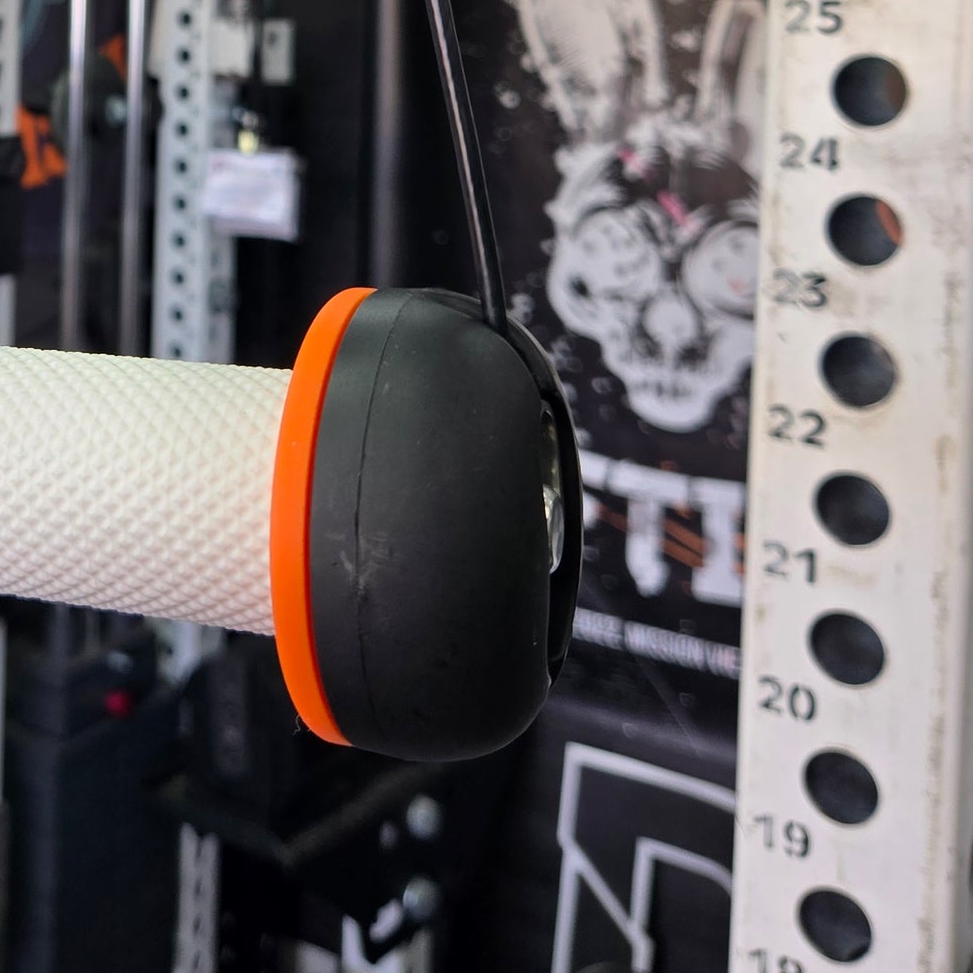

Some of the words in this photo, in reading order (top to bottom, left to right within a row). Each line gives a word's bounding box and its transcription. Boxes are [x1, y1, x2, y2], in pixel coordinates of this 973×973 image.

[780, 132, 839, 171] 24
[773, 268, 828, 309] 23
[769, 405, 827, 448] 22
[764, 540, 816, 584] 21
[760, 676, 818, 722] 20
[754, 814, 811, 858] 19
